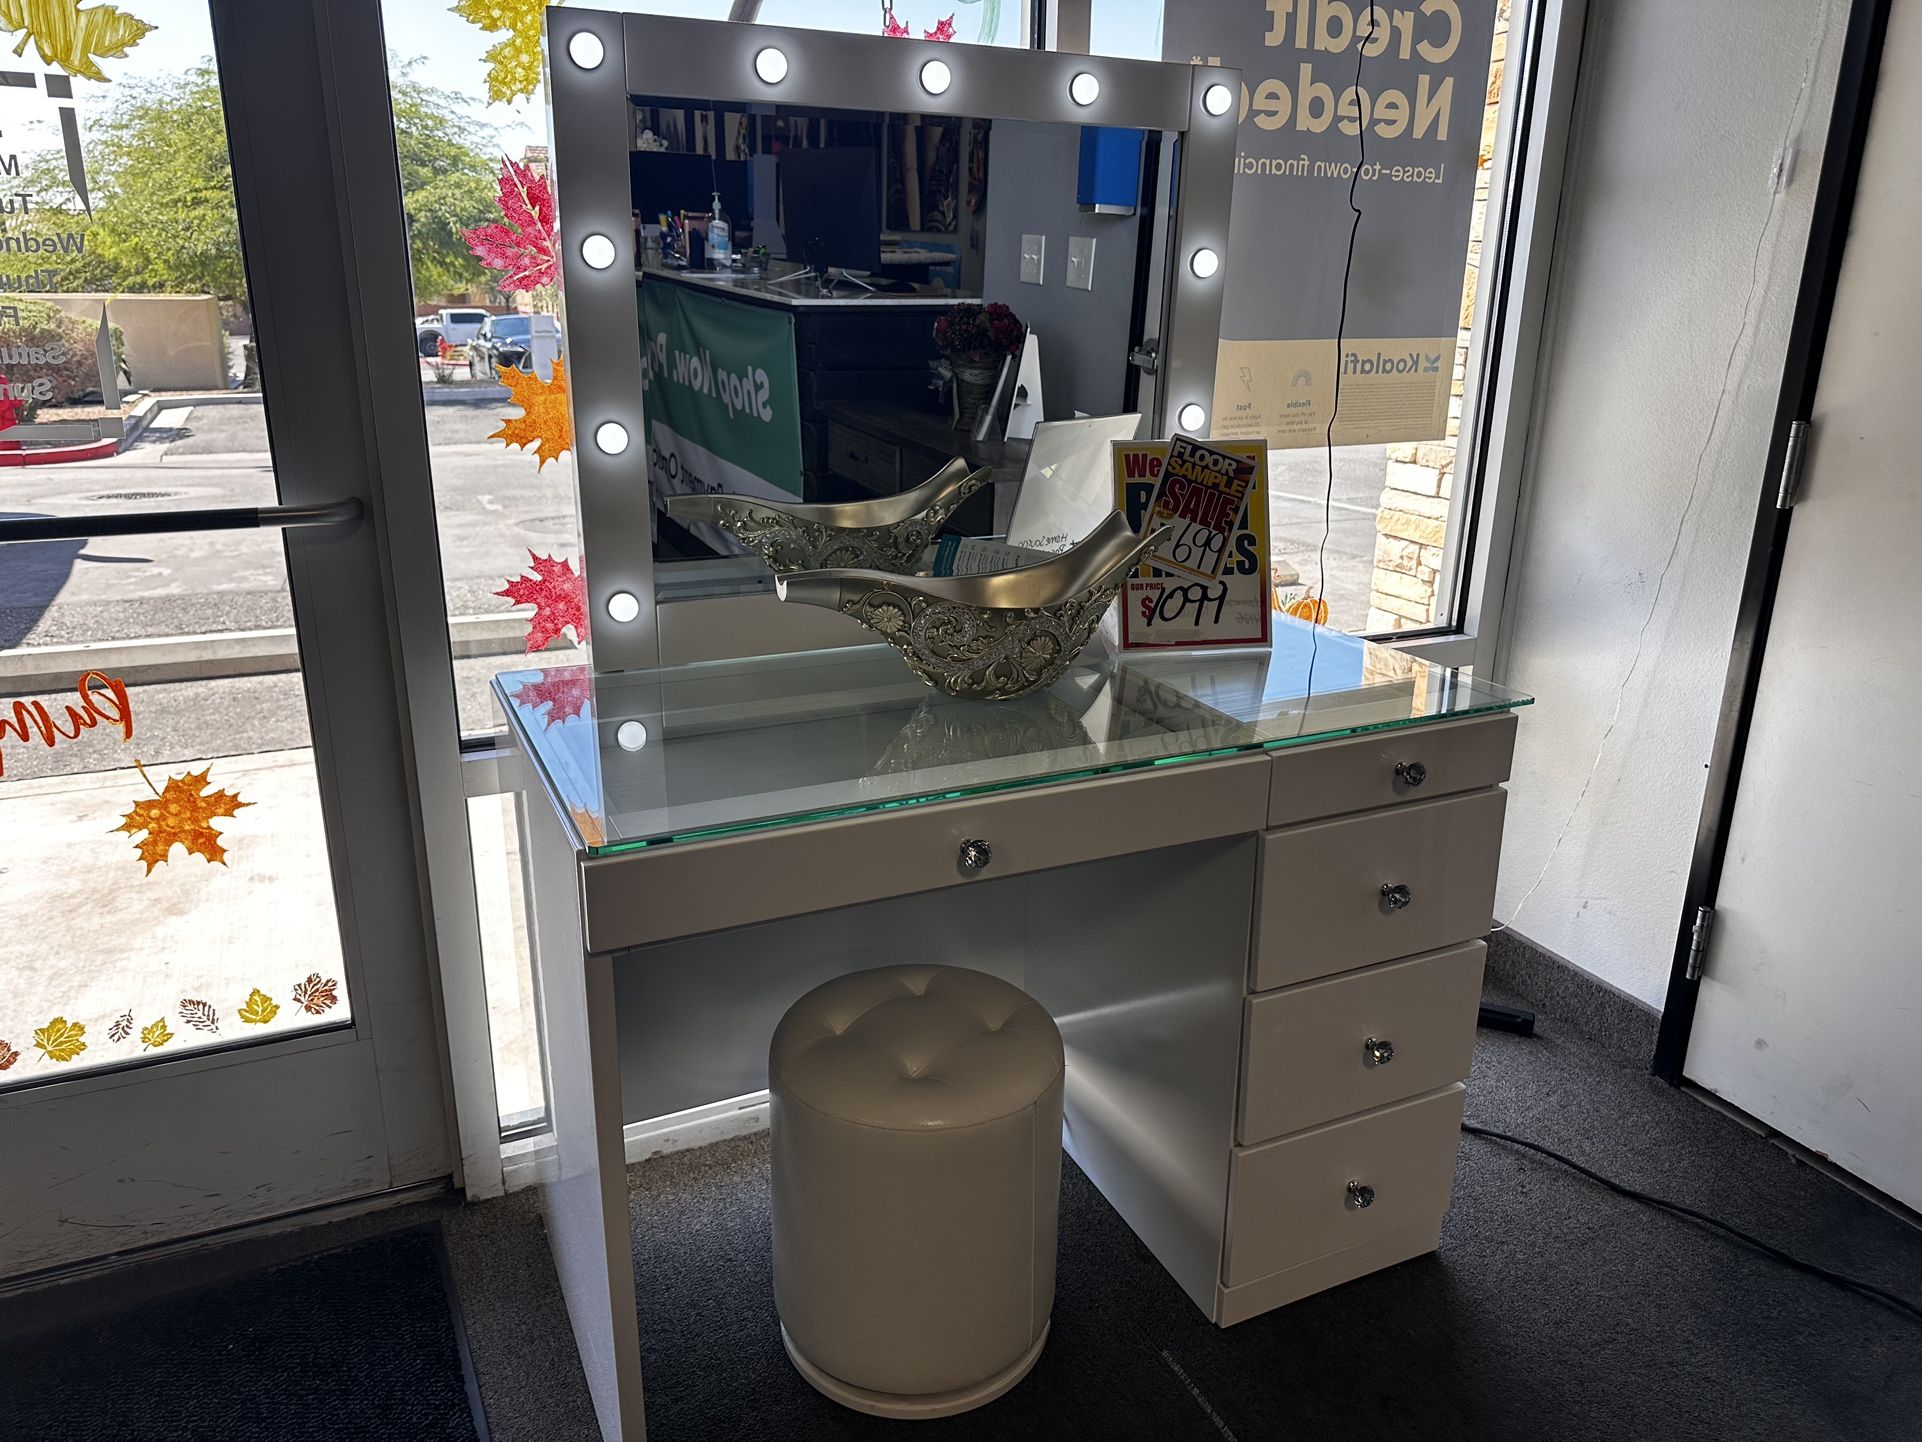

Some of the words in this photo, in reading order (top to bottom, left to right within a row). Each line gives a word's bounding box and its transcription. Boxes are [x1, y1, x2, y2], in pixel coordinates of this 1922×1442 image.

[1124, 453, 1163, 479] We
[1167, 456, 1247, 497] SAMPLE
[1172, 440, 1237, 477] FLOOR
[1161, 478, 1238, 533] SALE
[1172, 522, 1226, 575] 699
[1130, 582, 1144, 591] OUR
